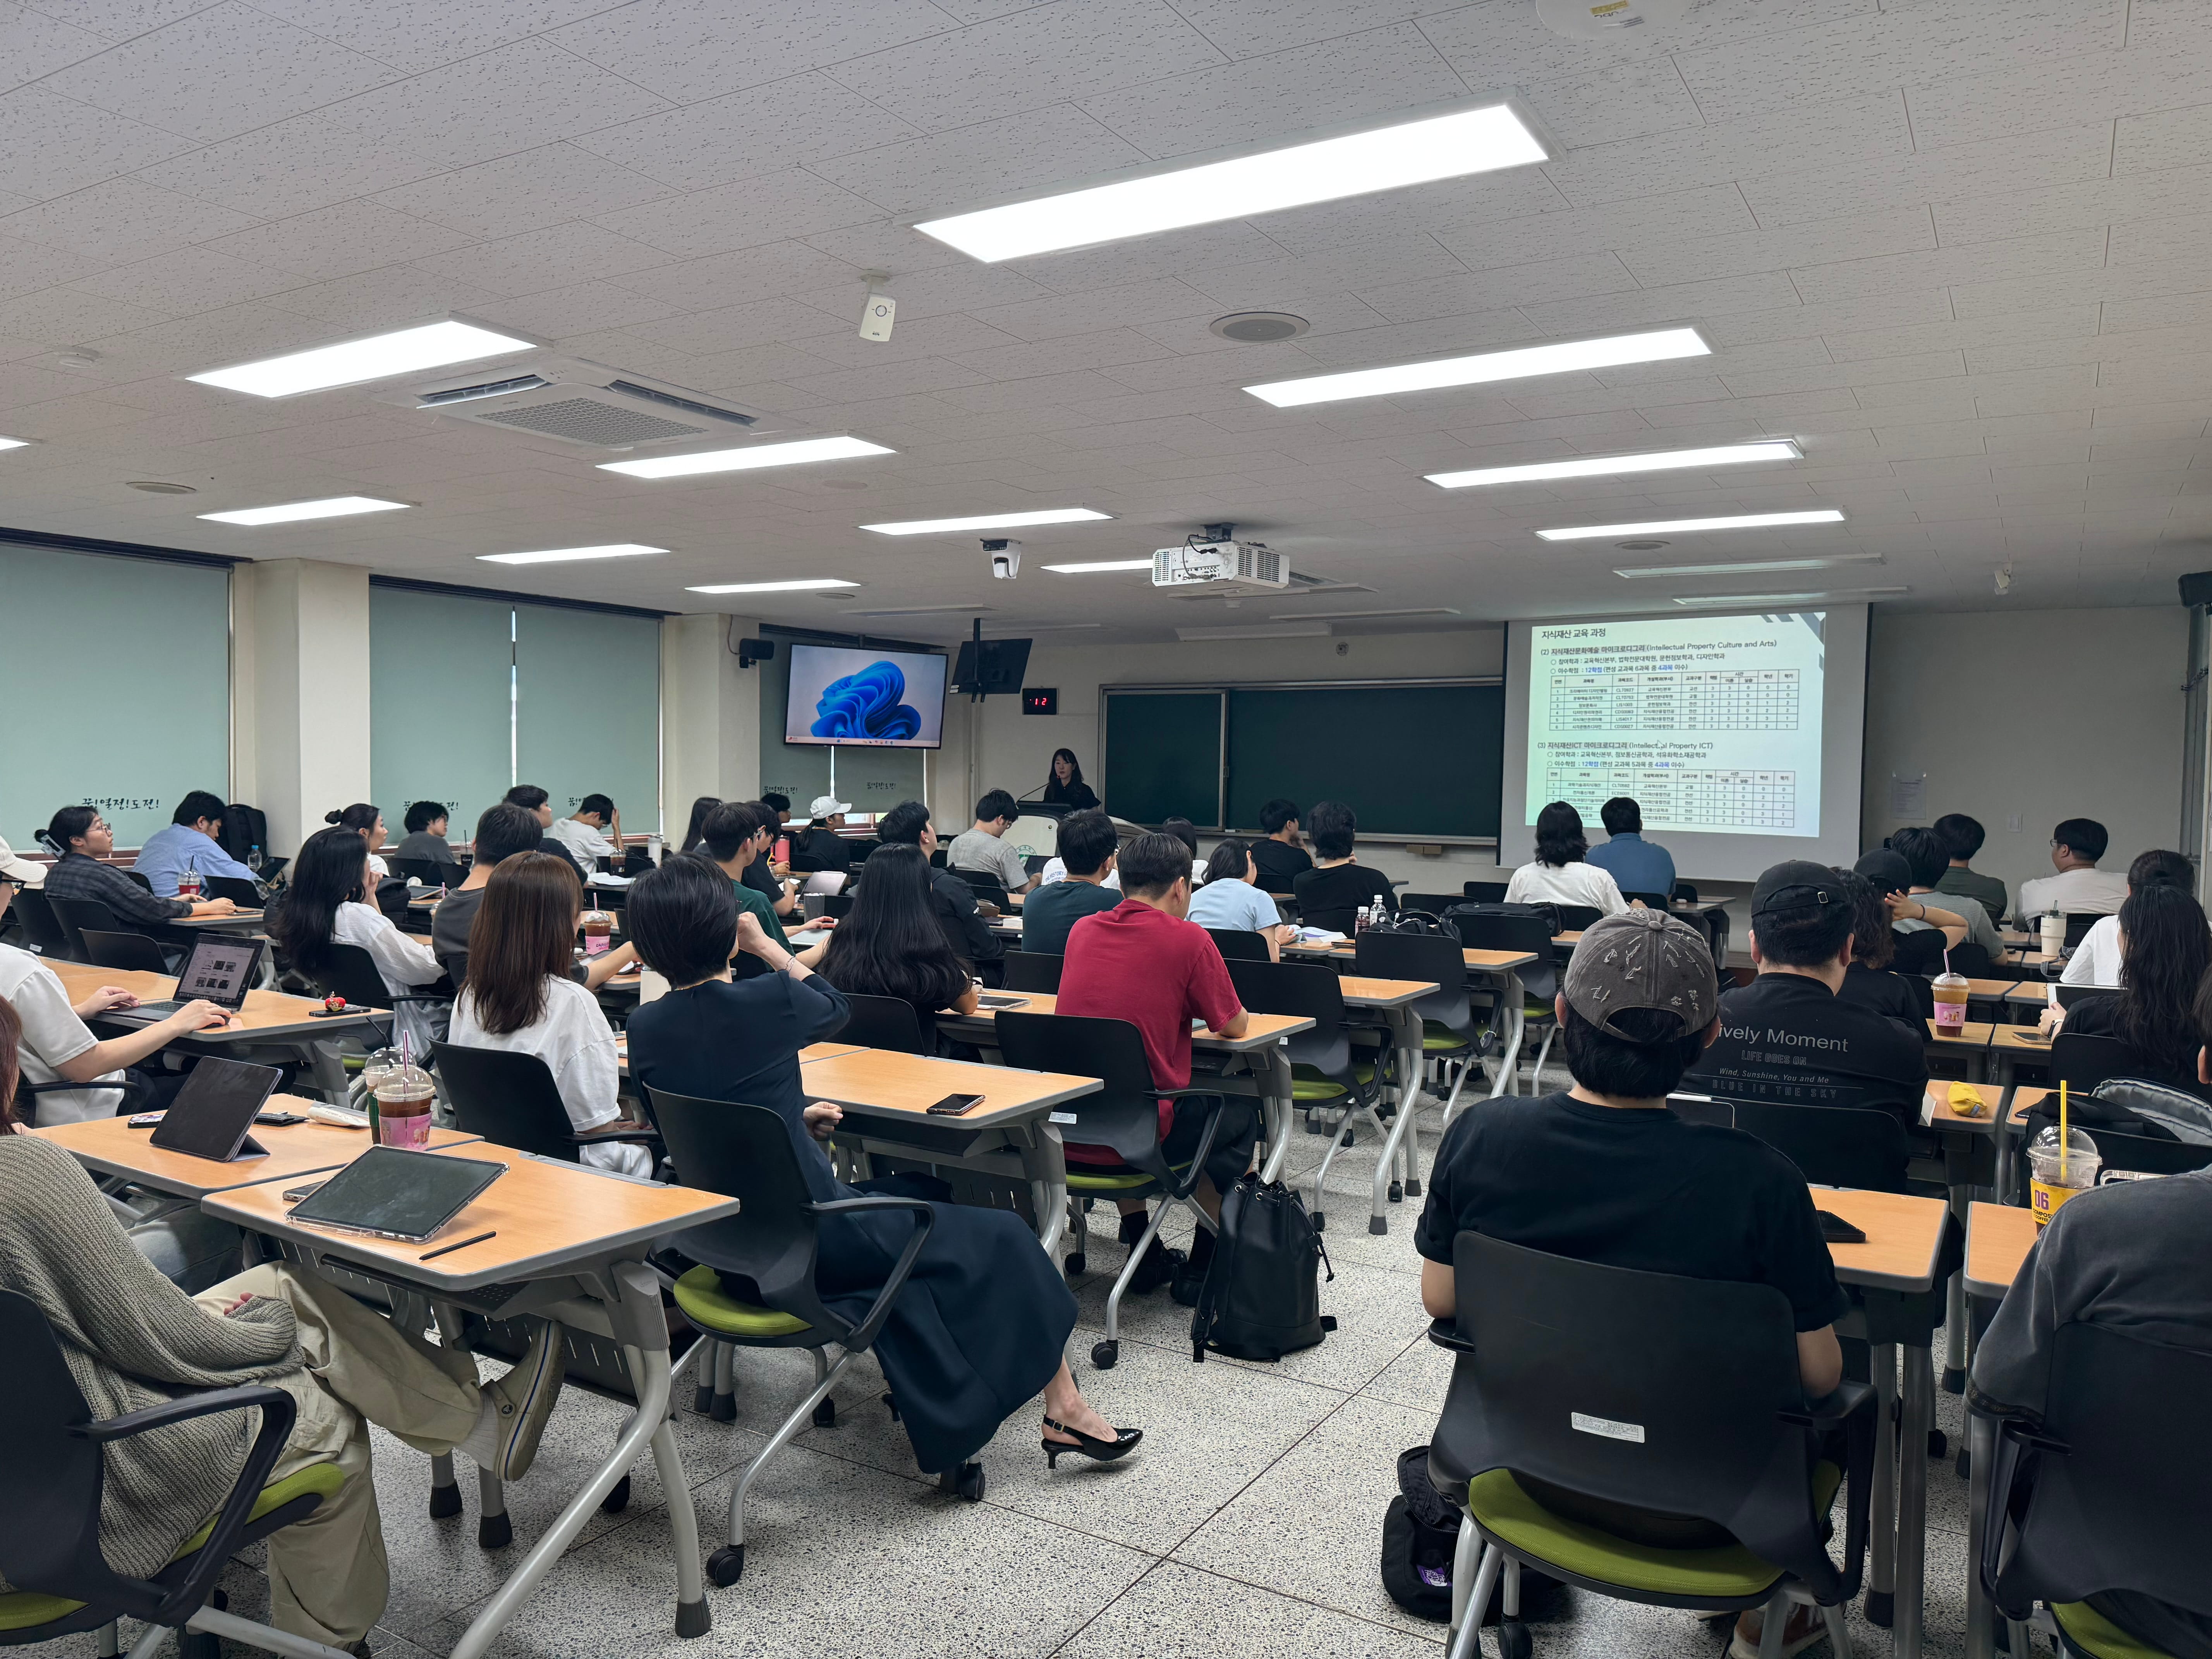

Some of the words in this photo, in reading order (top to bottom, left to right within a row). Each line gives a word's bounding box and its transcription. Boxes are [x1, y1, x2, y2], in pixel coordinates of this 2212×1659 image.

[1542, 630, 1571, 639] 지식재산
[1573, 629, 1589, 638] 교육
[1590, 628, 1606, 637] 과정
[1601, 645, 1644, 653] 마이크로디그리
[1647, 643, 1685, 651] (Intellectual
[1687, 642, 1715, 650] Property
[1719, 1023, 1760, 1044] ively
[1767, 1029, 1848, 1052] Moment
[1741, 1050, 1762, 1061] LIFE
[1793, 1056, 1807, 1065] ON
[1719, 1068, 1739, 1077] Wind,
[1742, 1070, 1779, 1081] Sunshine,
[1712, 1080, 1743, 1091] BLUE
[1753, 1084, 1766, 1093] IN
[1776, 1086, 1800, 1096] THE
[1810, 1088, 1836, 1098] SKY
